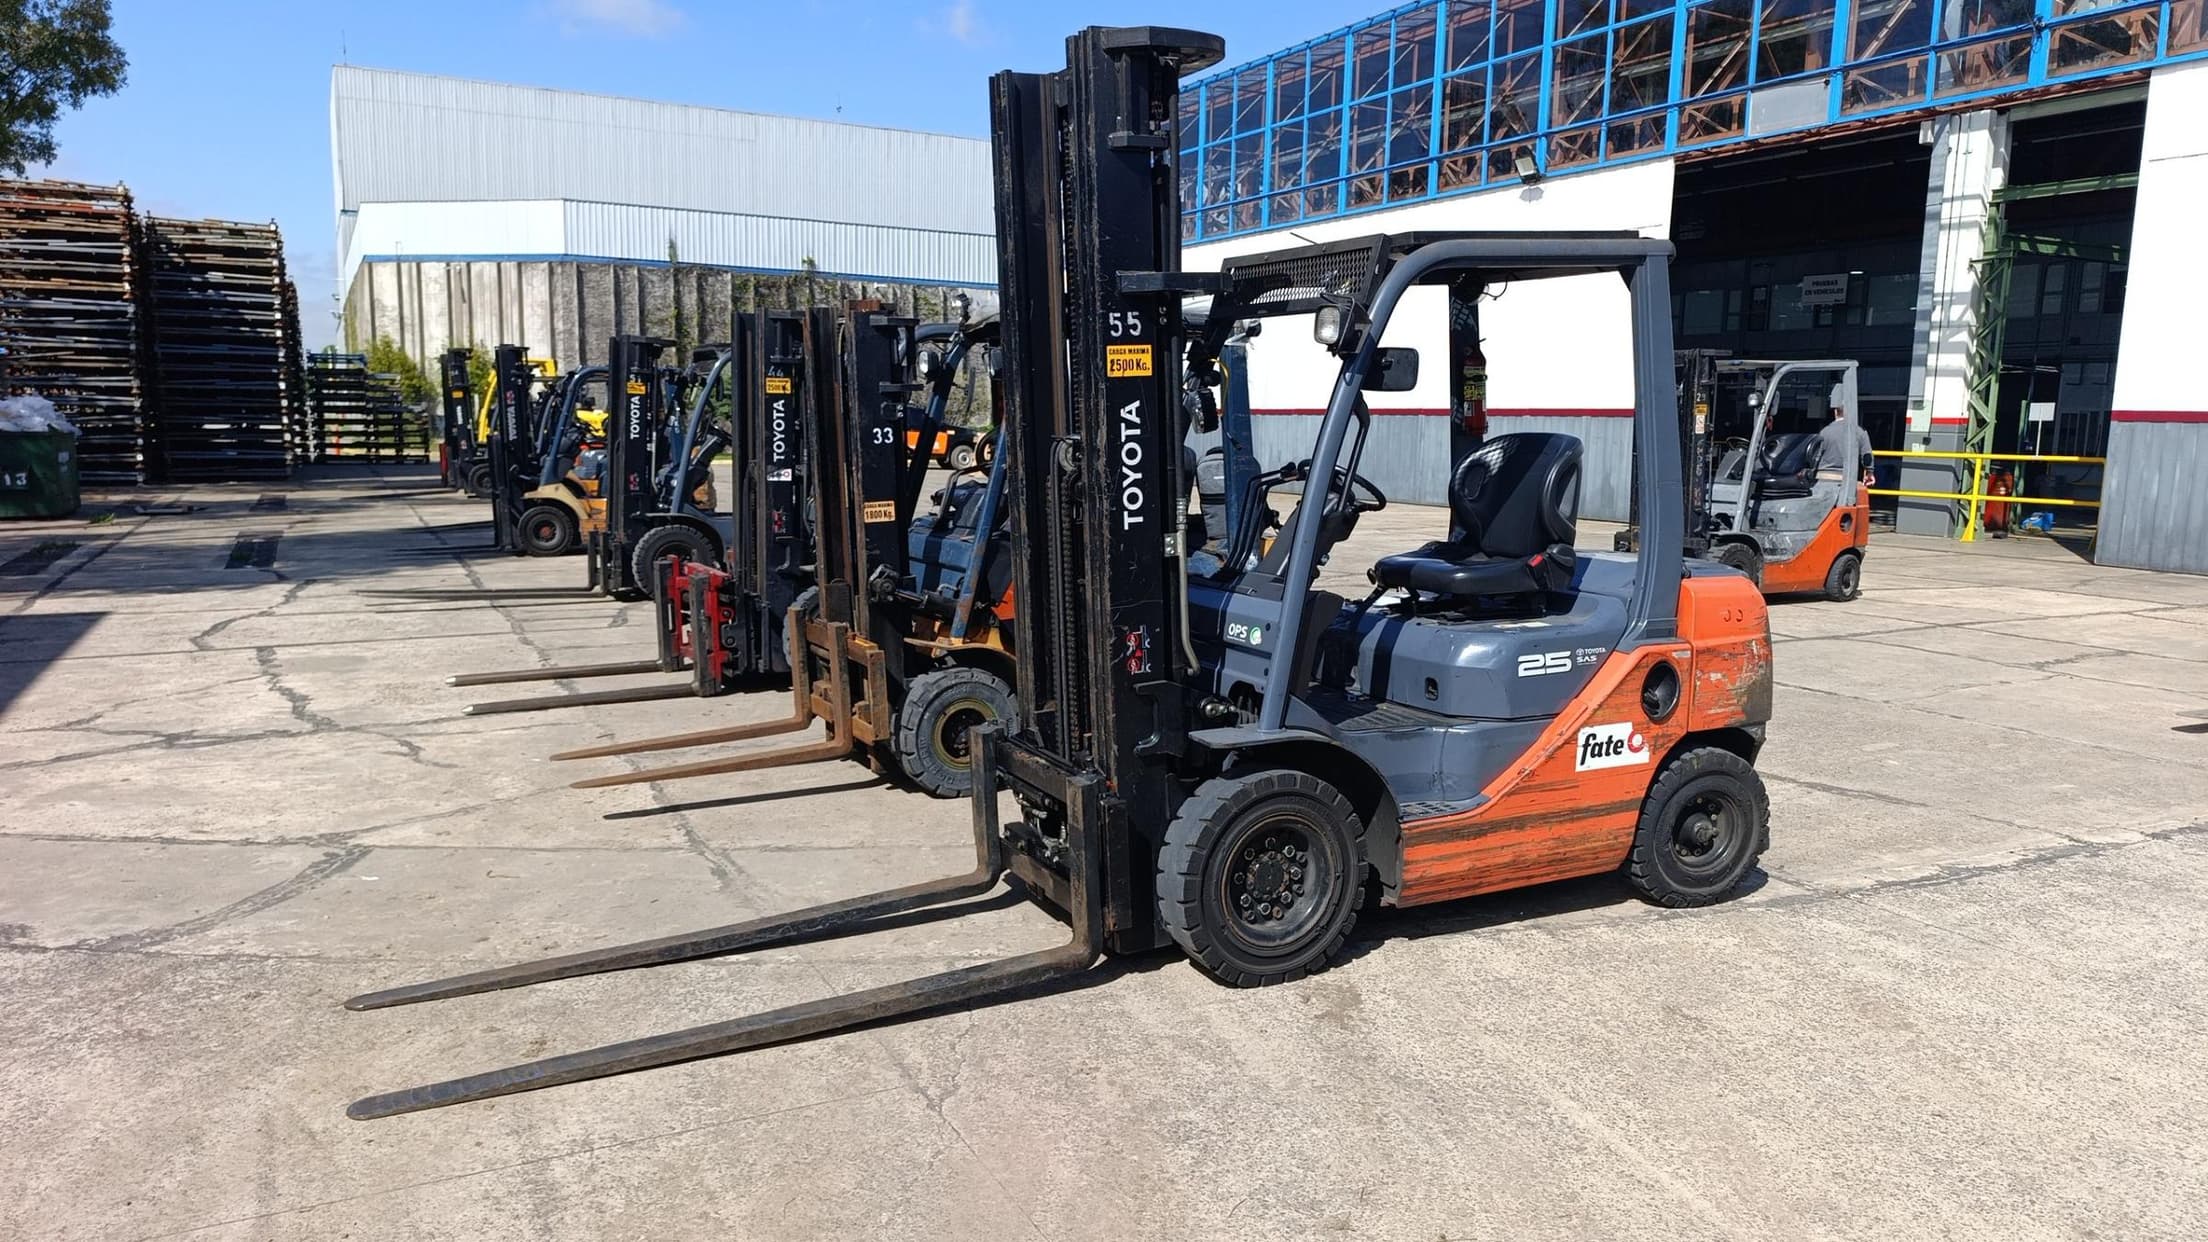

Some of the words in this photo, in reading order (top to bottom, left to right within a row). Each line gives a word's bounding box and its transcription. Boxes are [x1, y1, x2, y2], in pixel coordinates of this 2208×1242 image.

[1109, 312, 1142, 337] 55
[1110, 359, 1134, 372] 2500
[630, 396, 640, 440] TOYOTA
[773, 400, 786, 462] TOYOTA
[872, 427, 894, 445] 33
[1120, 400, 1144, 530] TOYOTA
[1228, 623, 1248, 638] OPS
[1517, 651, 1572, 677] 25
[1584, 647, 1607, 655] TOYOTA
[1576, 654, 1598, 662] SAS
[1580, 732, 1625, 766] fate
